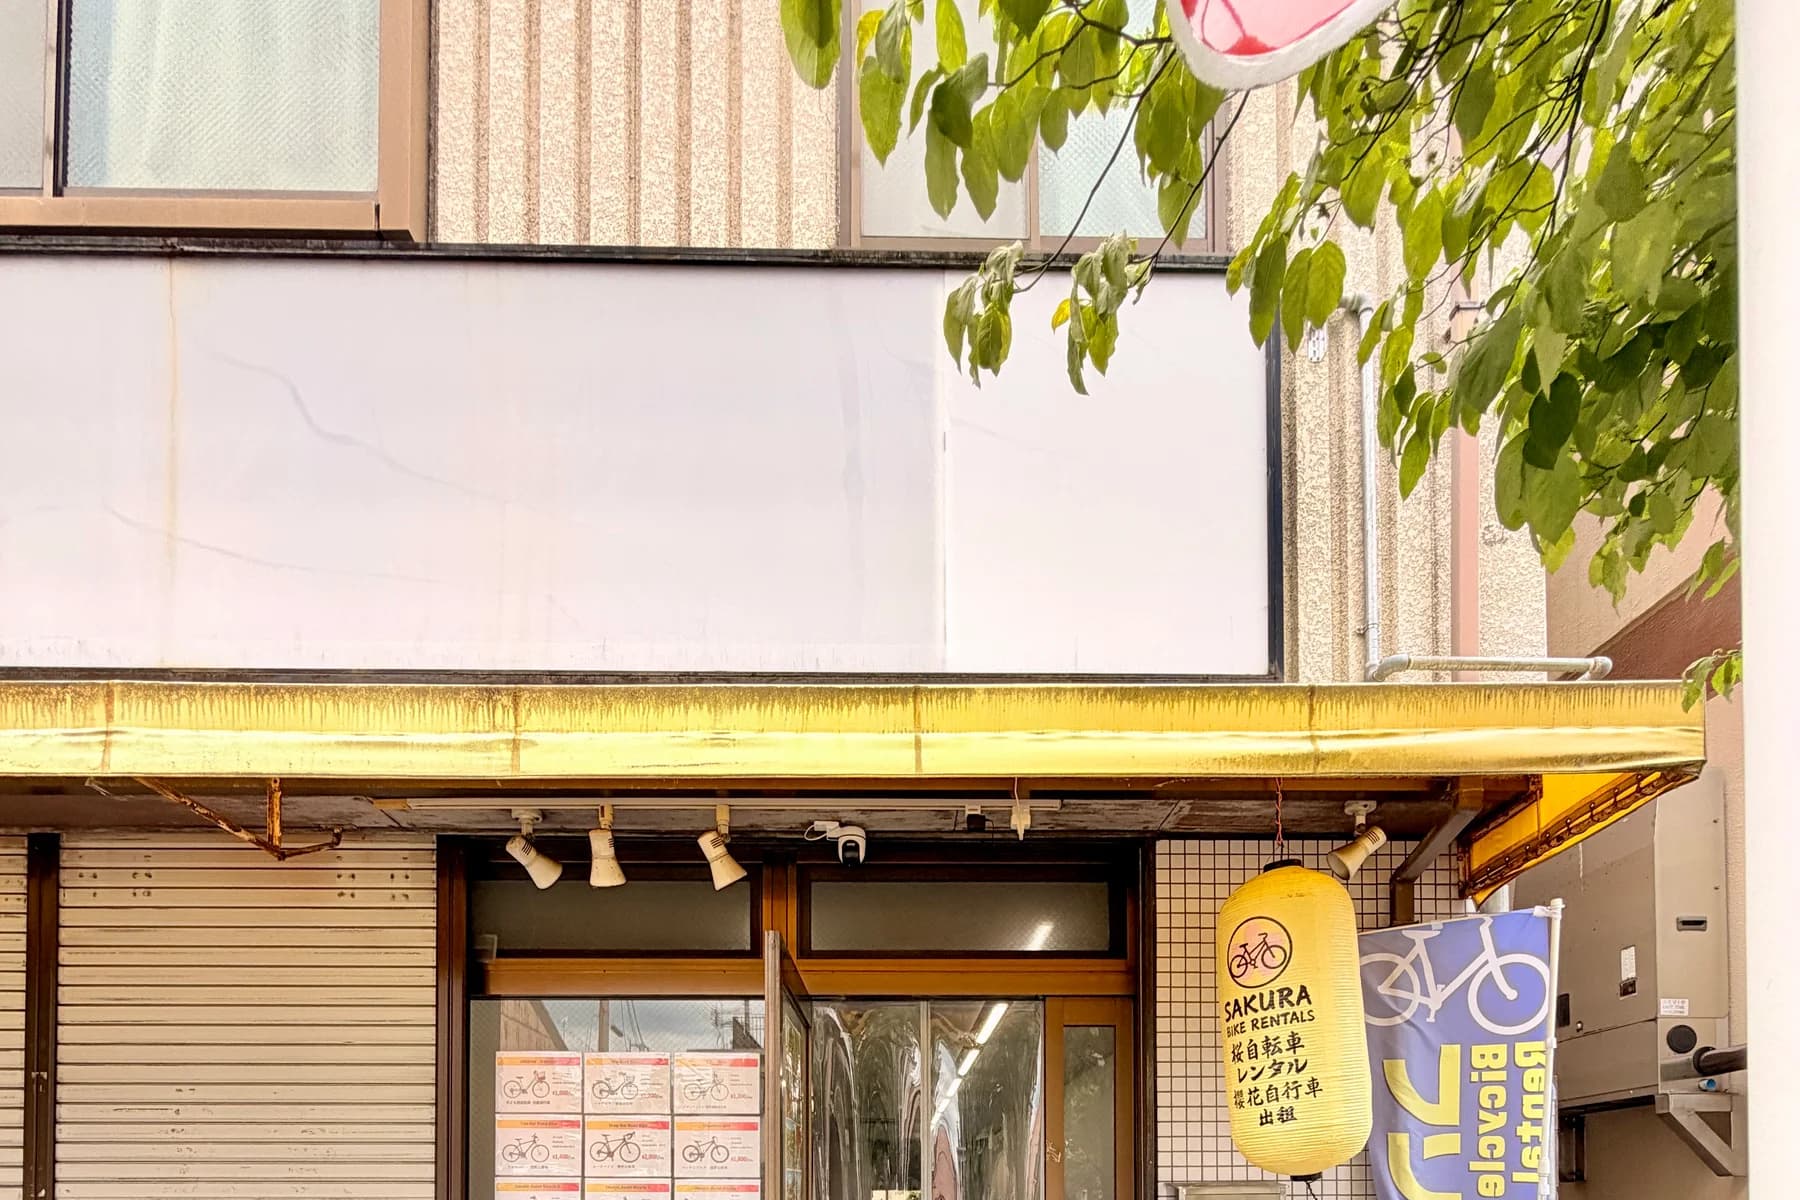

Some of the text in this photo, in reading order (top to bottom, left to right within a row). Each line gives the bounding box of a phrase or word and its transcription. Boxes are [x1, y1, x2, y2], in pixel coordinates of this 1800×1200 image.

[1225, 984, 1312, 1023] SAKURA
[1227, 1009, 1316, 1038] BIKE RENTALS
[1231, 1031, 1305, 1063] 桜自転車
[1238, 1058, 1308, 1084] レンタル
[1259, 1106, 1297, 1127] 出租
